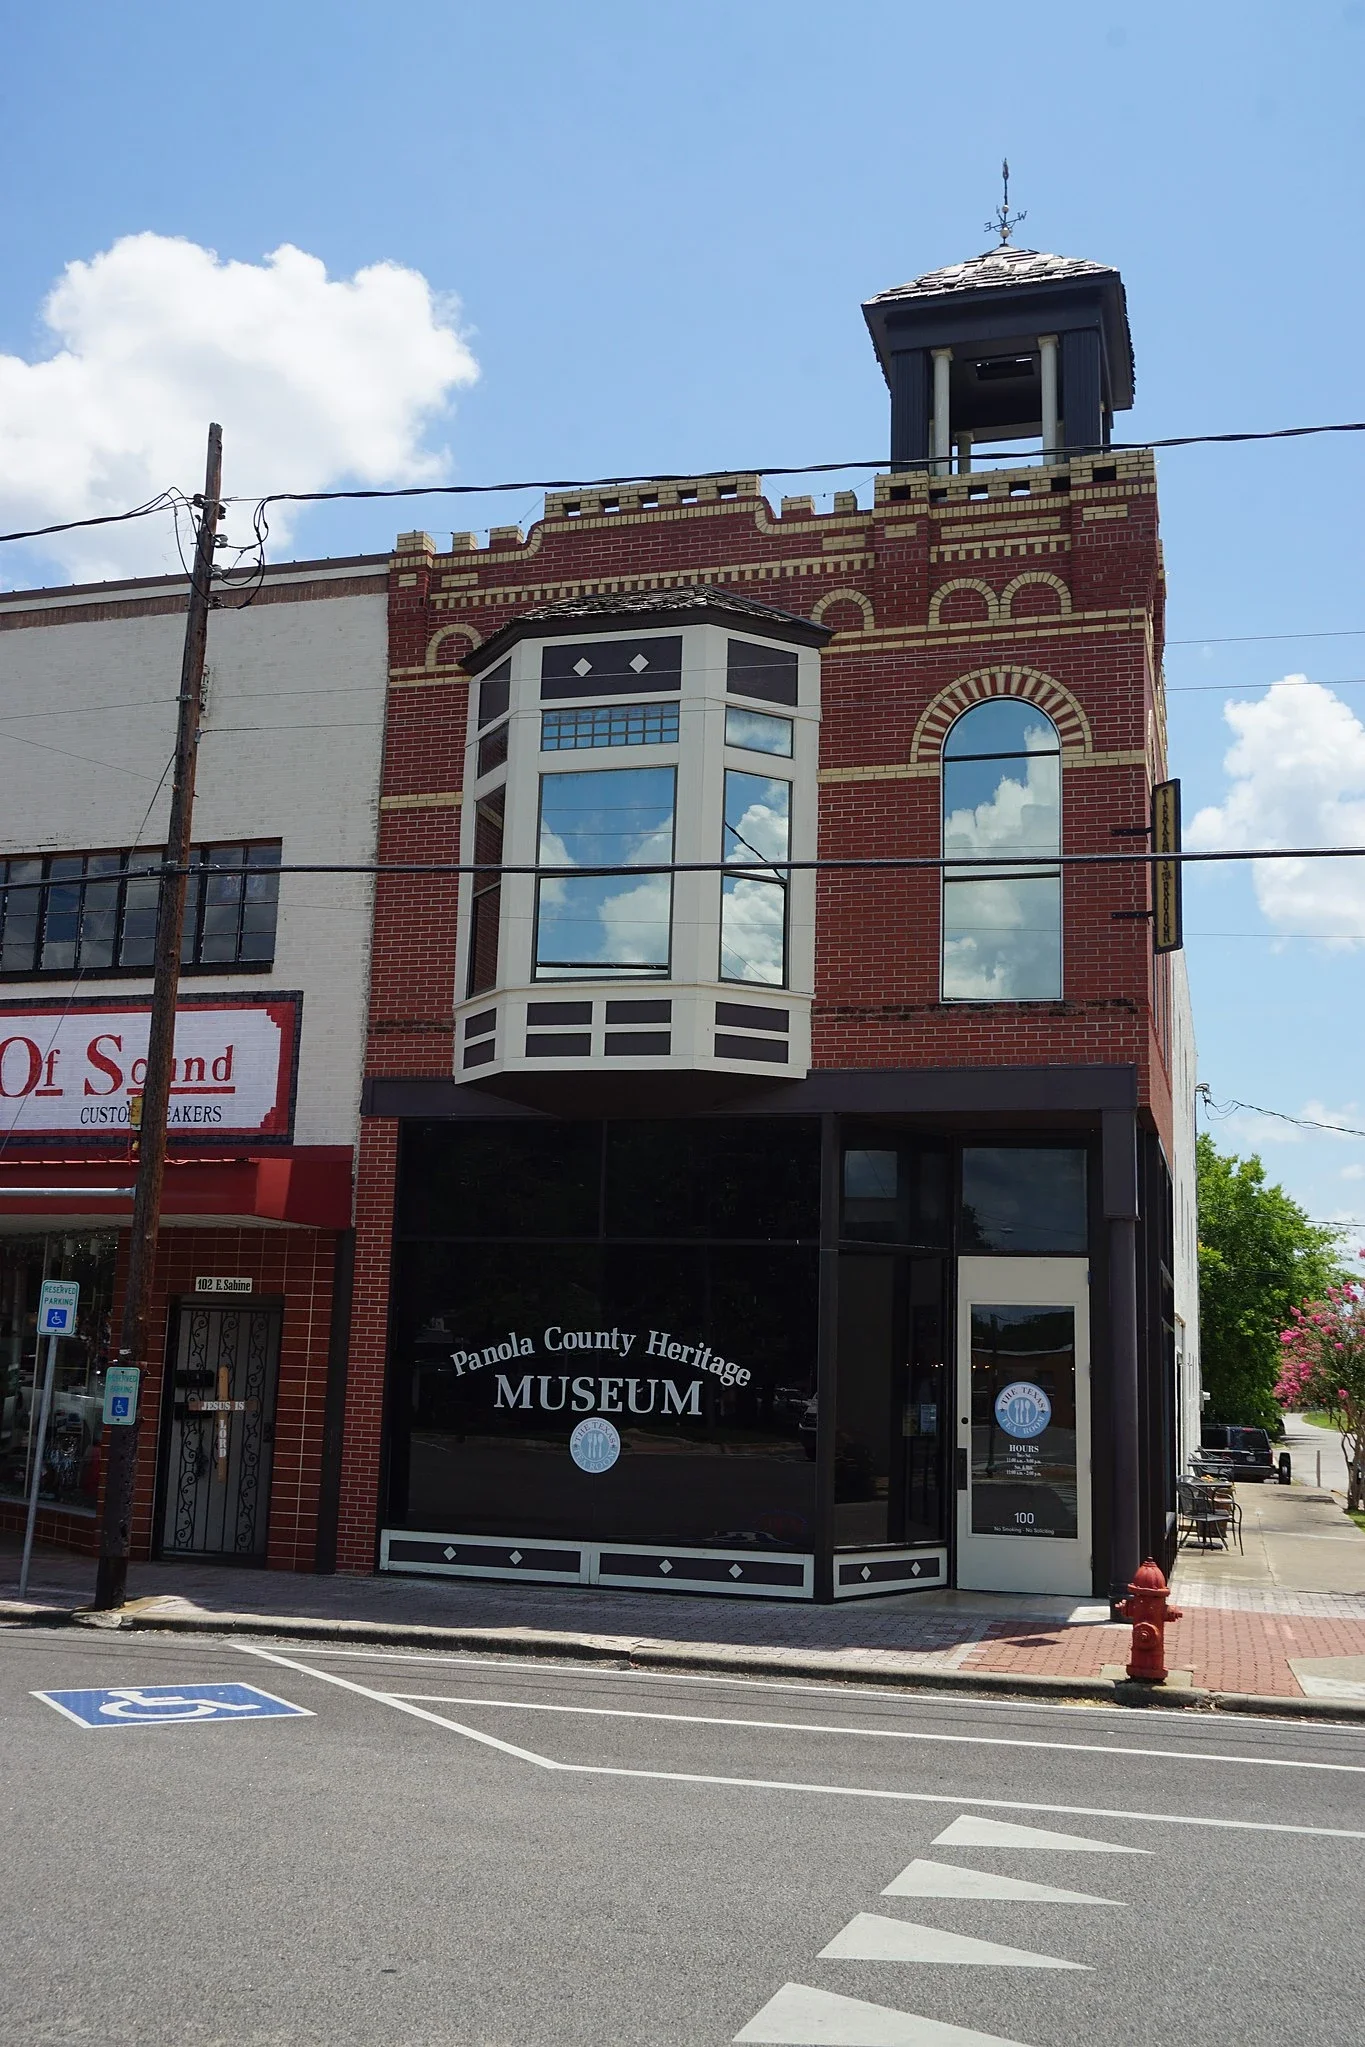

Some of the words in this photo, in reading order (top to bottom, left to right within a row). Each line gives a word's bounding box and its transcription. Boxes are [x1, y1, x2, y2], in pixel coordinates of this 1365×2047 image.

[1162, 881, 1172, 943] ROOM
[0, 1036, 61, 1098] Of
[84, 1034, 235, 1096] Sond
[80, 1106, 132, 1124] CUSTO
[44, 1285, 76, 1295] RESERVED
[197, 1278, 213, 1291] 102
[223, 1279, 251, 1292] Sabine
[44, 1298, 74, 1306] PARKING
[450, 1332, 535, 1377] Panola
[544, 1326, 637, 1357] County
[645, 1330, 751, 1387] Heritage
[493, 1374, 703, 1415] MUSEUM
[1001, 1388, 1018, 1404] THE
[1021, 1387, 1046, 1408] TEXAS
[201, 1401, 231, 1411] JESUS
[234, 1401, 245, 1411] IS
[575, 1423, 591, 1441] THE
[592, 1421, 616, 1443] TEXAS
[1002, 1416, 1017, 1433] TEA
[1023, 1416, 1045, 1434] ROOM
[218, 1419, 227, 1458] LORD
[1009, 1444, 1039, 1453] HOURS
[1014, 1512, 1035, 1524] 100
